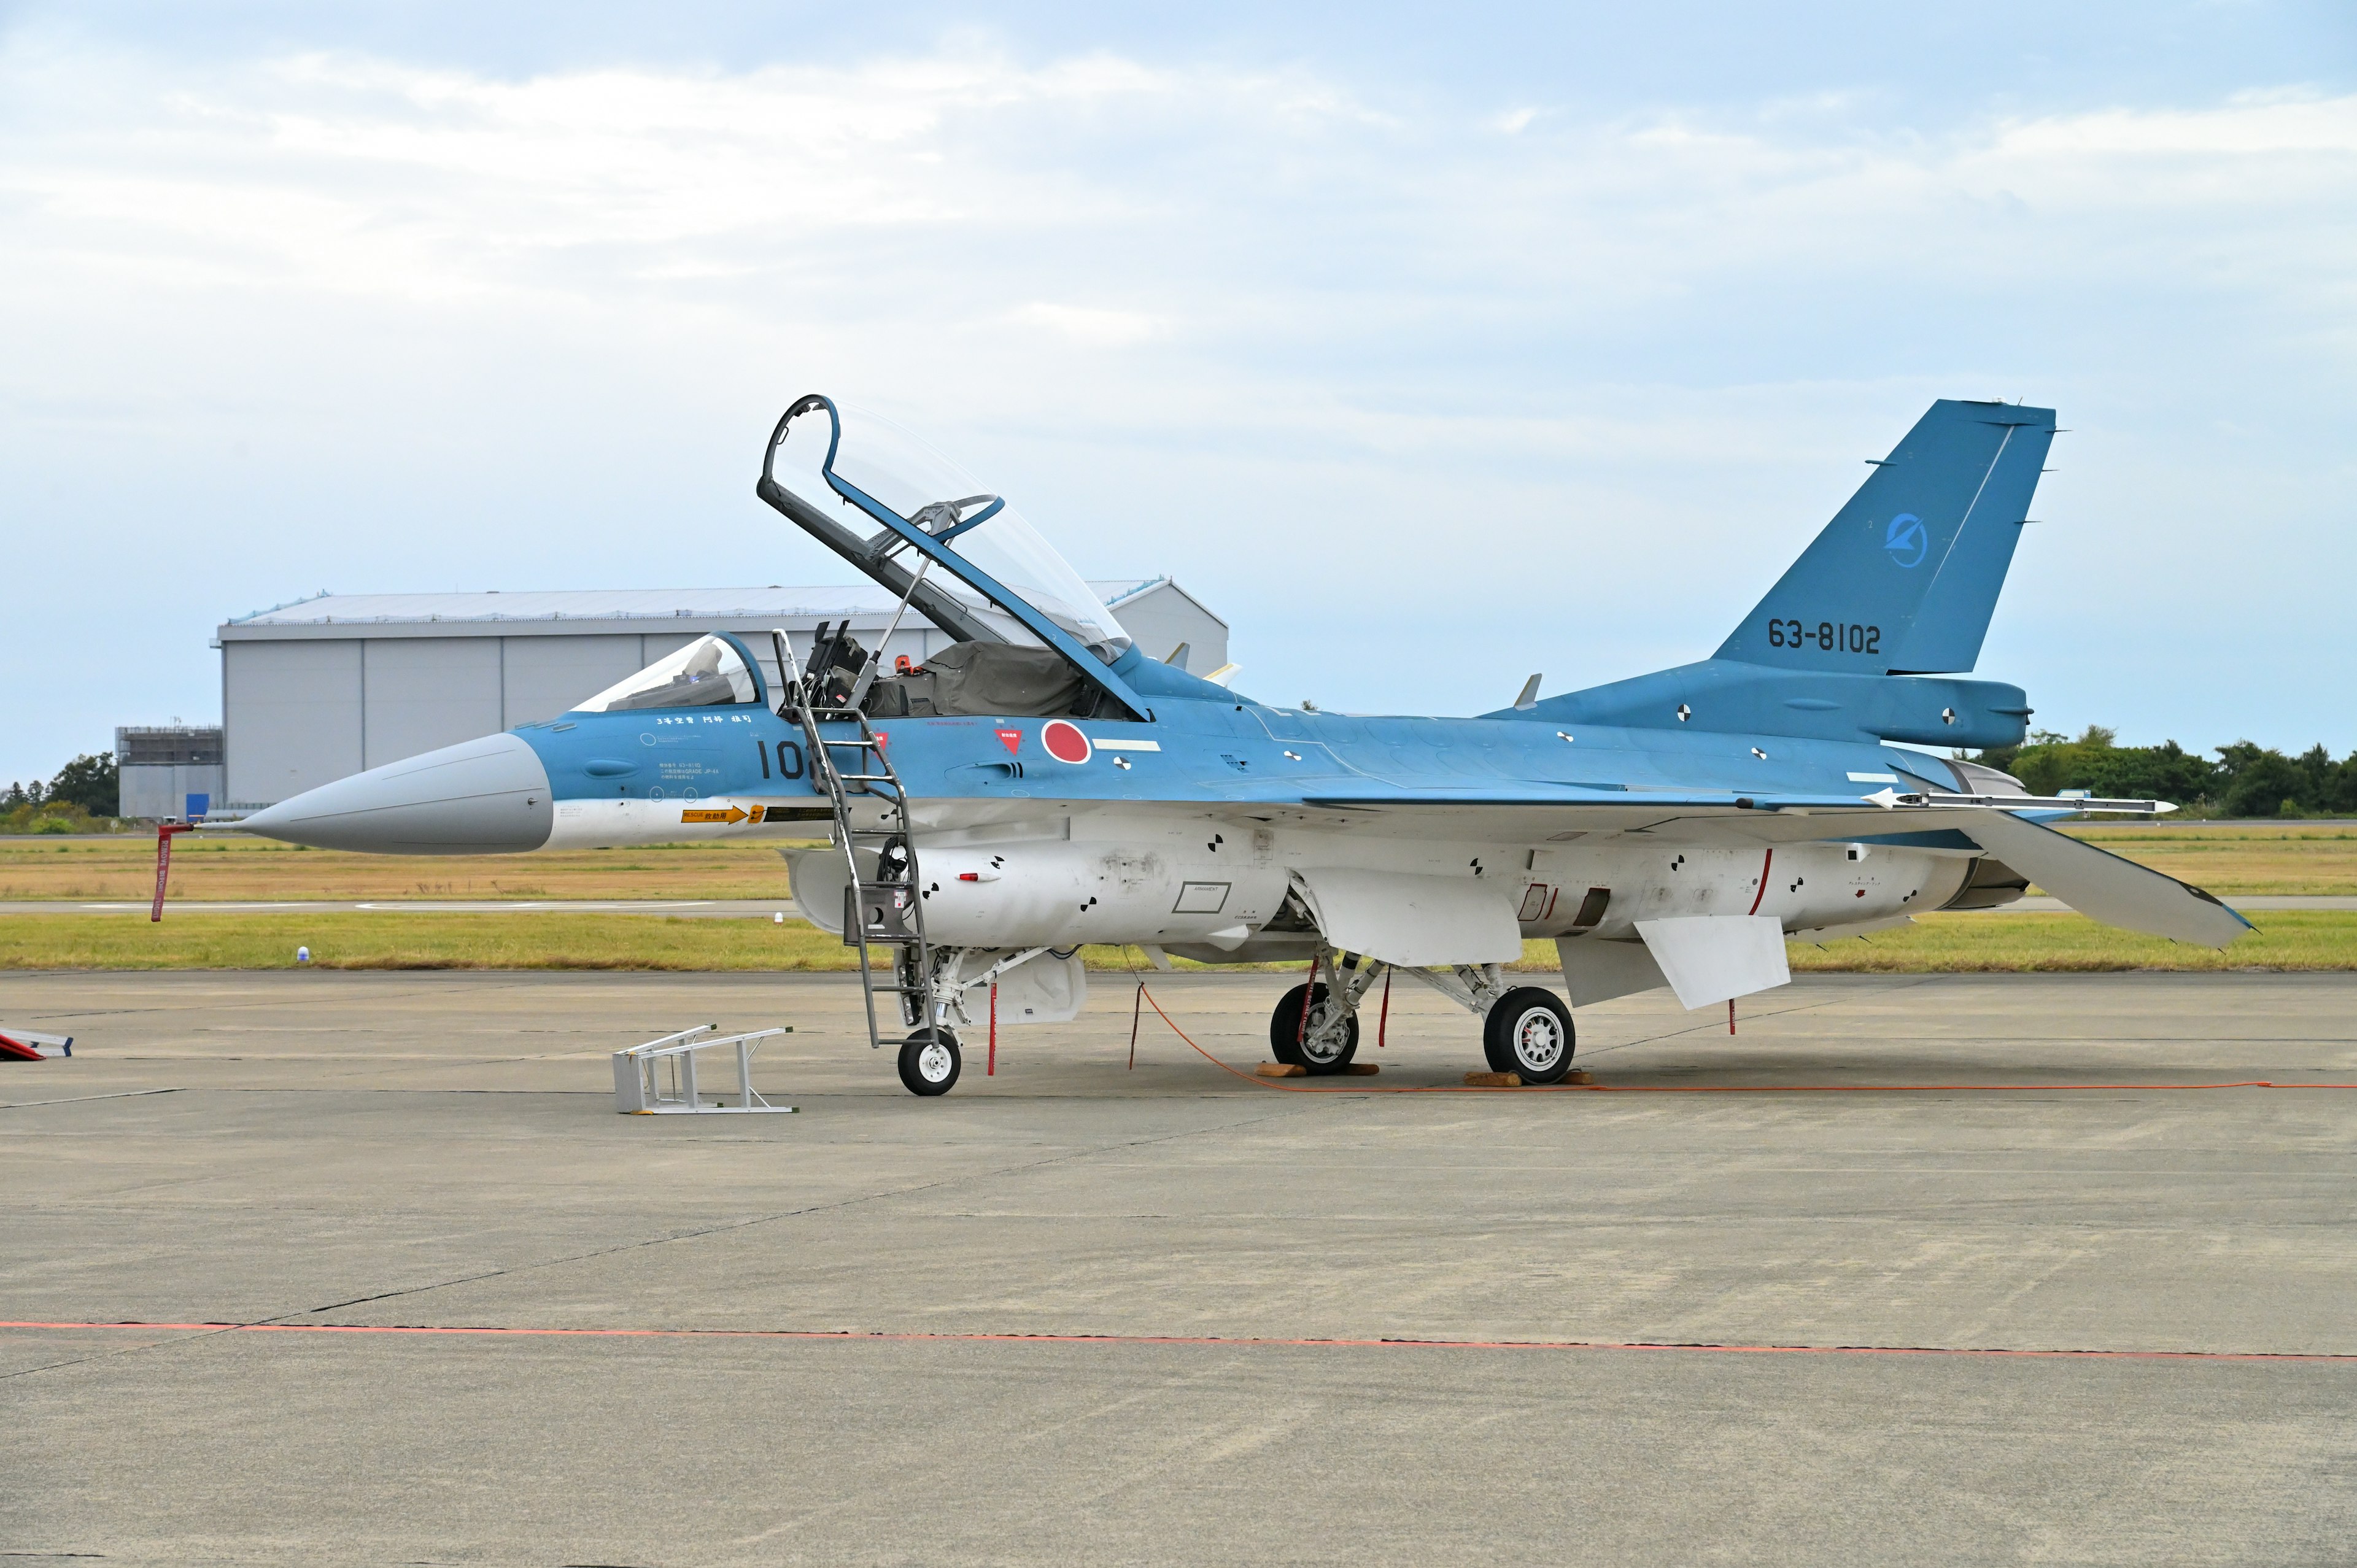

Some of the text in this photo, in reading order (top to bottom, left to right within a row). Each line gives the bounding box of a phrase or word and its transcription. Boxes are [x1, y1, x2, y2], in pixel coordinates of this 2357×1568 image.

[1868, 520, 1873, 528] 2
[1051, 633, 1057, 642] 2
[1768, 618, 1880, 654] 63-8102
[160, 840, 169, 867] REMOVE
